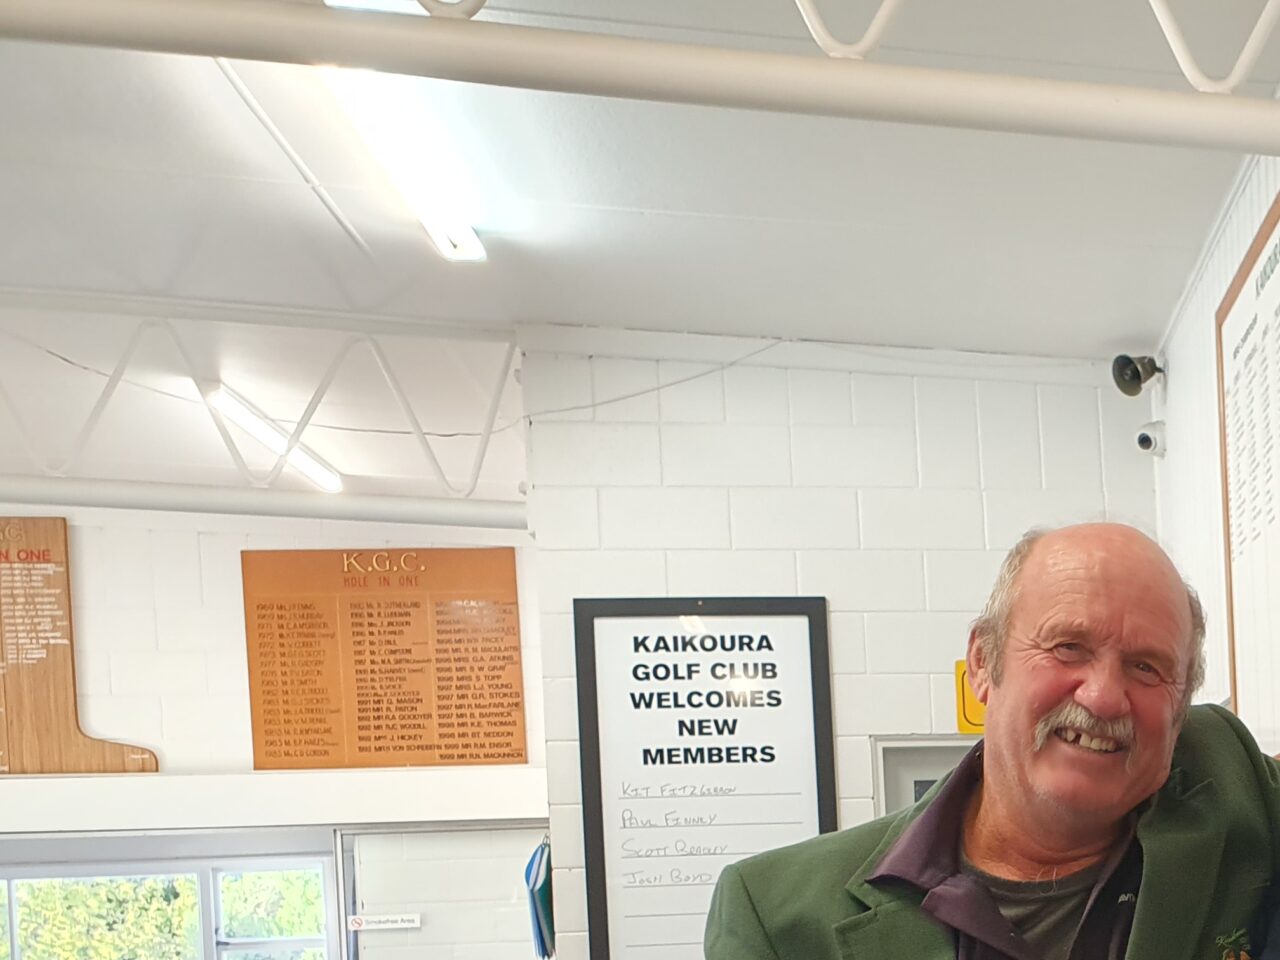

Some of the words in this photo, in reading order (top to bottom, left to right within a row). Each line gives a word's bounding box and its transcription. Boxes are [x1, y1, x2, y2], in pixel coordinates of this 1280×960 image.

[17, 550, 51, 561] ONE
[343, 551, 426, 573] K.G.C.
[343, 575, 368, 588] HOLE
[378, 575, 390, 588] IN
[399, 575, 418, 587] ONE
[633, 634, 774, 653] KAIKOURA
[632, 663, 701, 681] GOLF
[710, 662, 778, 680] CLUB
[629, 690, 782, 709] WELCOMES
[398, 712, 432, 720] GOODYER
[678, 718, 738, 737] NEW
[642, 745, 776, 765] MEMBERS
[621, 781, 650, 797] KIT
[621, 808, 657, 828] PAUL
[621, 837, 669, 857] SCOTT
[622, 870, 662, 884] JOSH
[670, 868, 713, 884] BOYD
